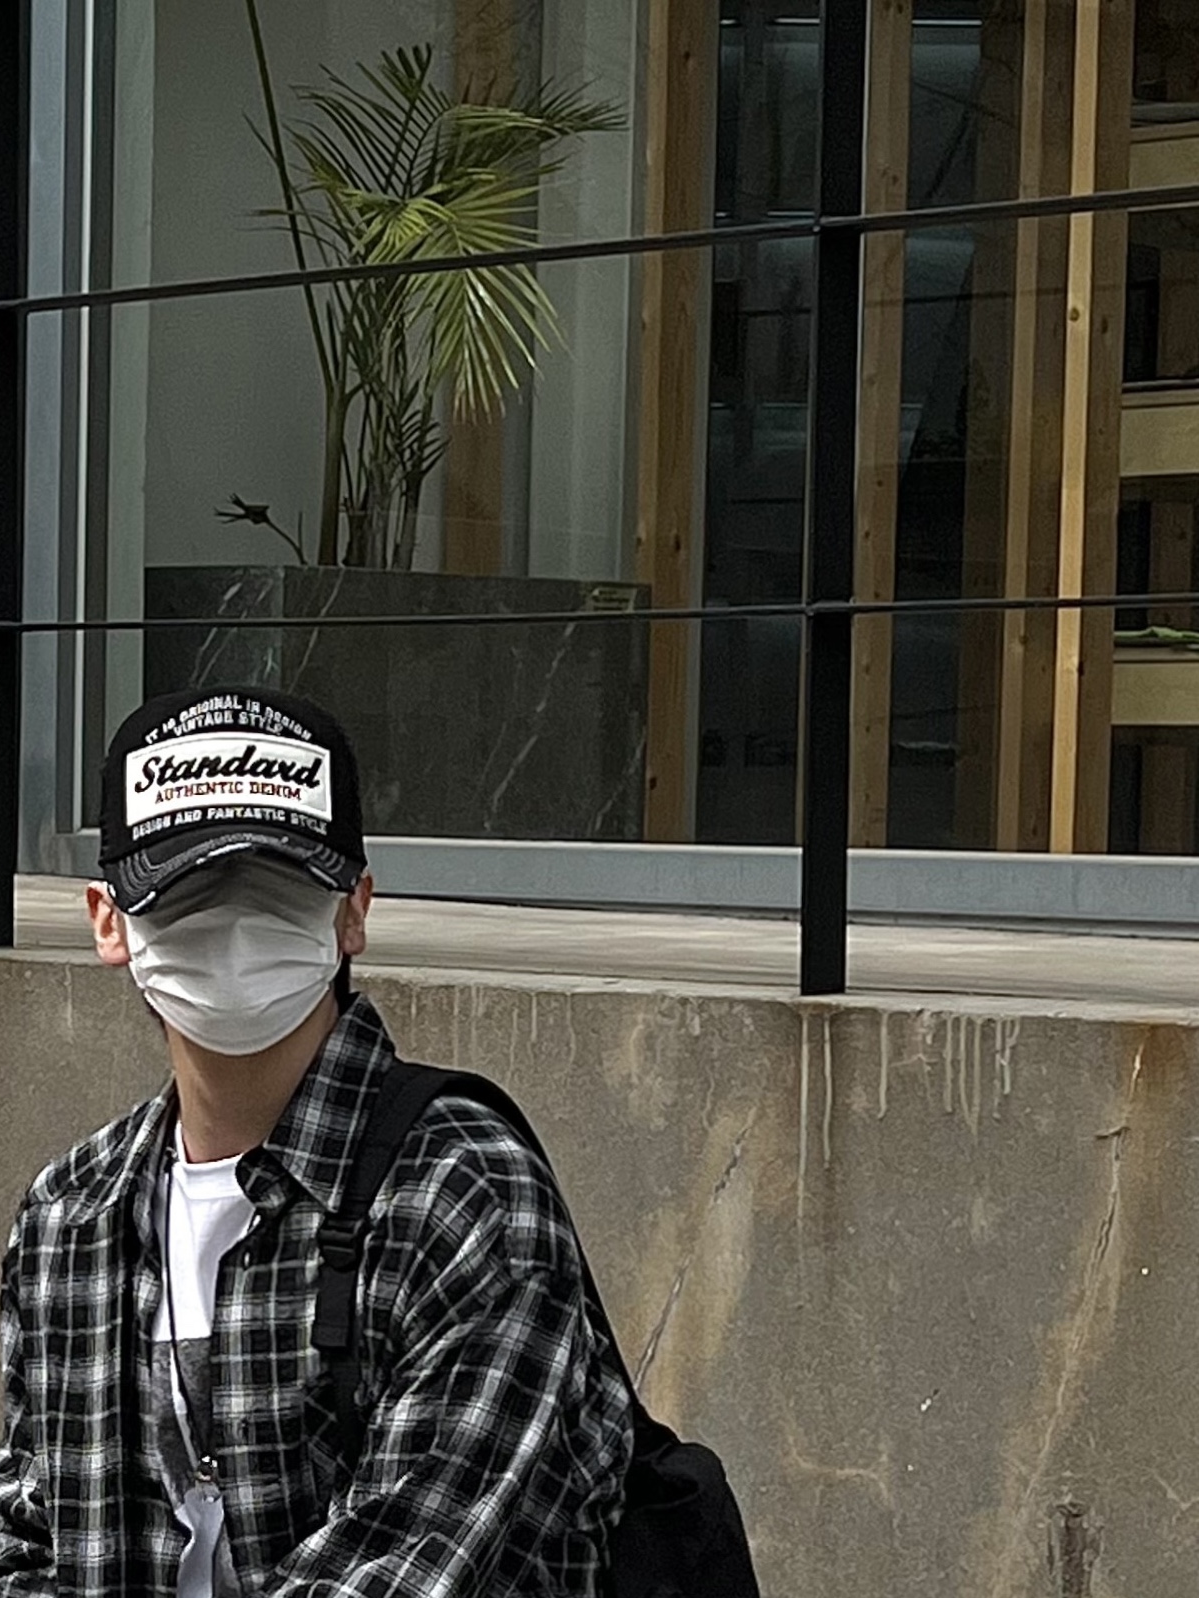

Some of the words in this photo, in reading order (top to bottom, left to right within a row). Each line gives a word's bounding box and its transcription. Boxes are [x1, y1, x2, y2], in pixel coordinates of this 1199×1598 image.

[179, 695, 242, 723] ORIGINAL
[173, 710, 234, 737] VINTAGE
[238, 711, 284, 735] STYLE
[134, 744, 323, 794] Standard
[155, 781, 244, 804] AUTHENTIC
[249, 781, 302, 801] DENIM
[174, 808, 201, 826] AND
[206, 807, 285, 822] FANTASTIC
[290, 812, 328, 836] STYLE
